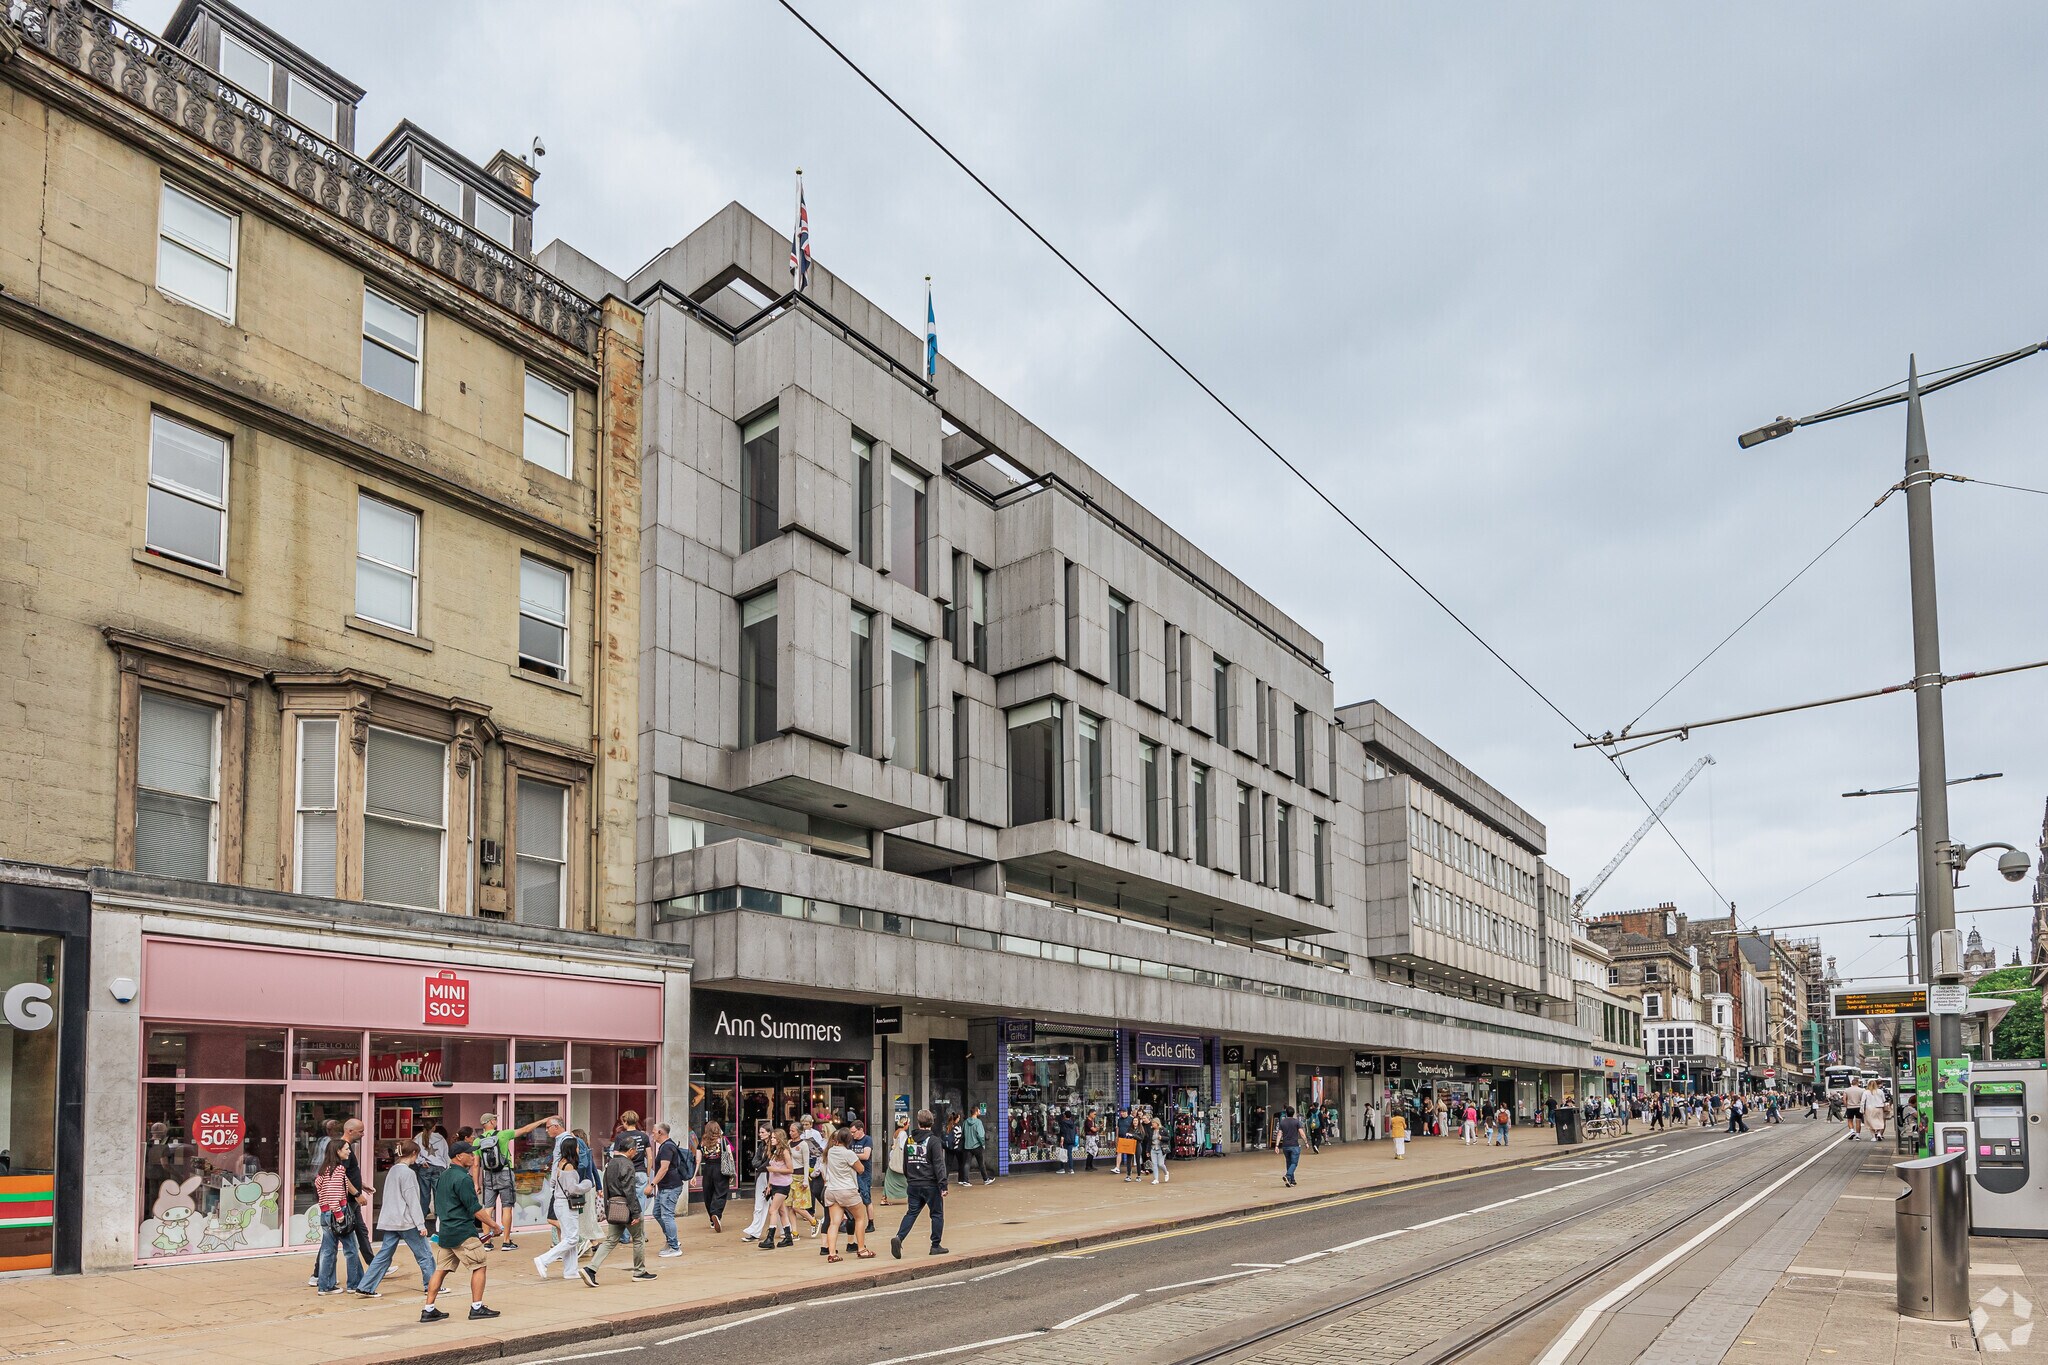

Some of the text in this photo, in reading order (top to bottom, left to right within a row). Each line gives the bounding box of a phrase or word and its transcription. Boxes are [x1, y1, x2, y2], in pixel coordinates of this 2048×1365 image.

[429, 983, 465, 1000] MINI
[714, 1010, 842, 1042] Ann Summers
[1008, 1022, 1028, 1032] Castle
[1010, 1032, 1026, 1040] Gifts
[1144, 1041, 1196, 1060] Castle Gifts
[1355, 1059, 1372, 1069] Regus
[1417, 1061, 1448, 1078] Superdrug
[200, 1112, 239, 1124] SALE
[200, 1128, 239, 1146] 50%
